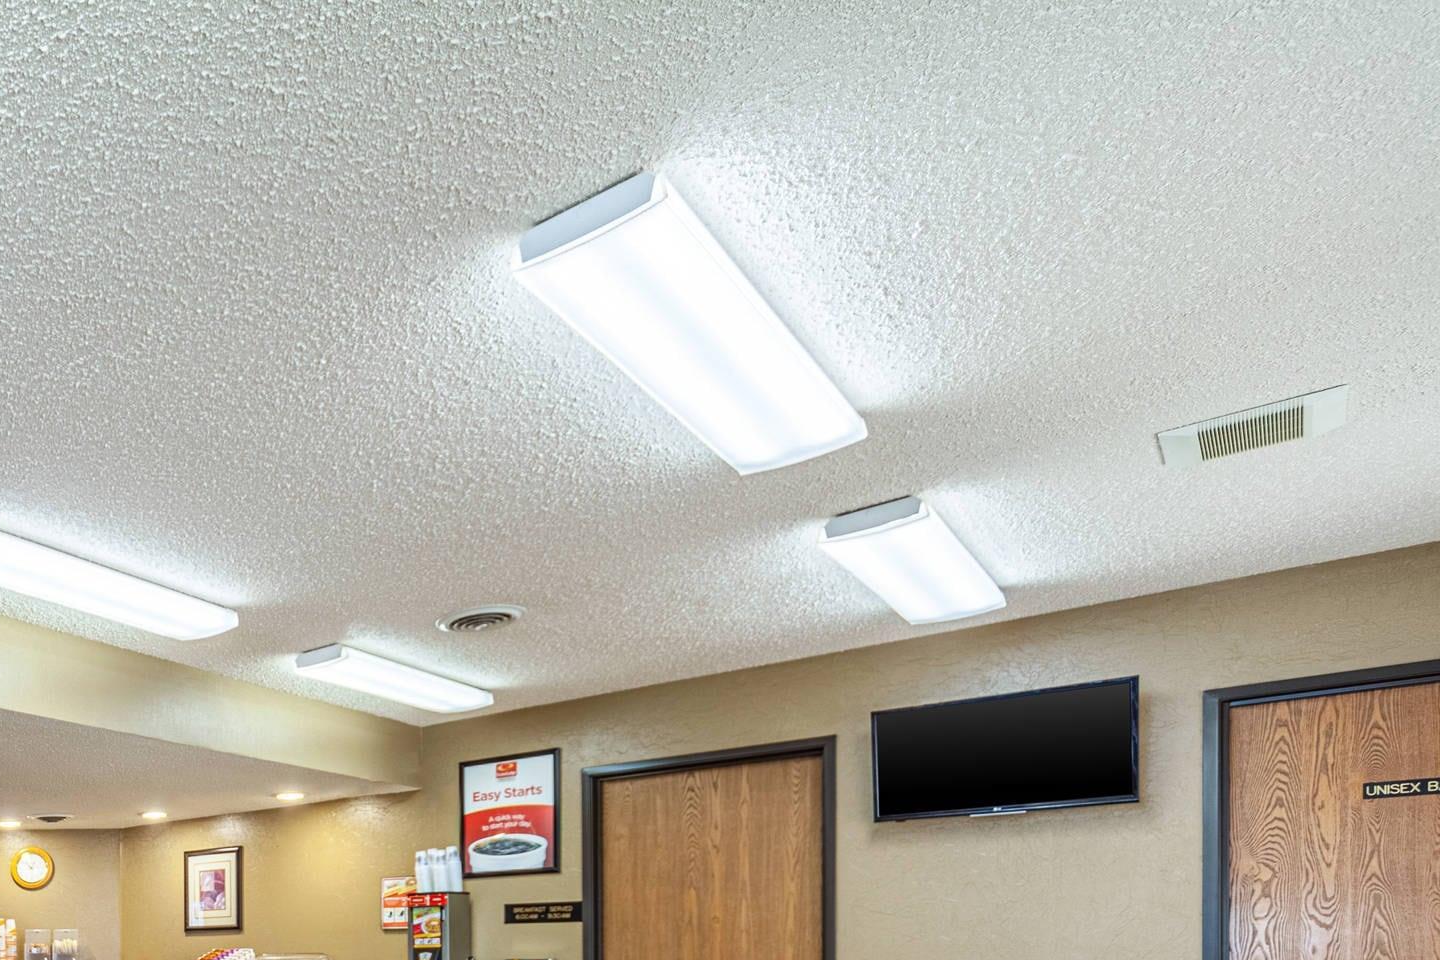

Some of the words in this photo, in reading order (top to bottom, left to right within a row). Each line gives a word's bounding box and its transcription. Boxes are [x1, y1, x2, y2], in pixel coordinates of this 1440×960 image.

[472, 790, 502, 802] Easy
[504, 785, 542, 799] Starts
[1366, 782, 1420, 796] UNISEX
[1427, 780, 1440, 792] B
